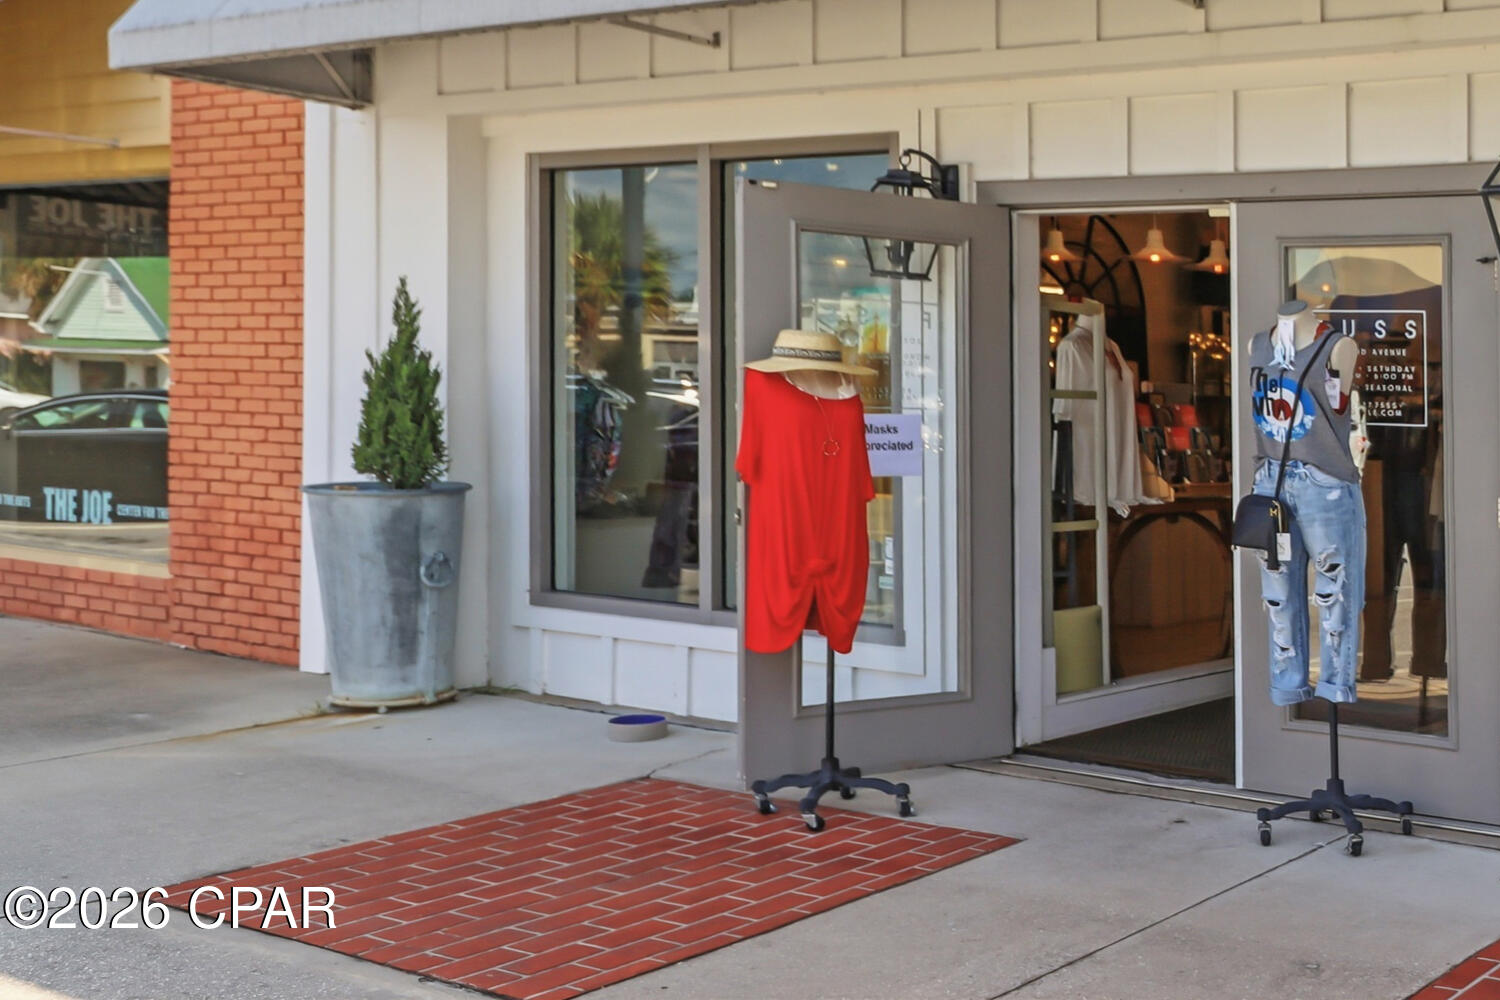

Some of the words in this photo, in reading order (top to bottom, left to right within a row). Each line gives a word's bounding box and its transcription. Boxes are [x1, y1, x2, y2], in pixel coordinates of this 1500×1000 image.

[1341, 319, 1417, 339] USS
[866, 441, 914, 451] reciated
[43, 486, 78, 522] THE
[81, 489, 113, 525] JOE
